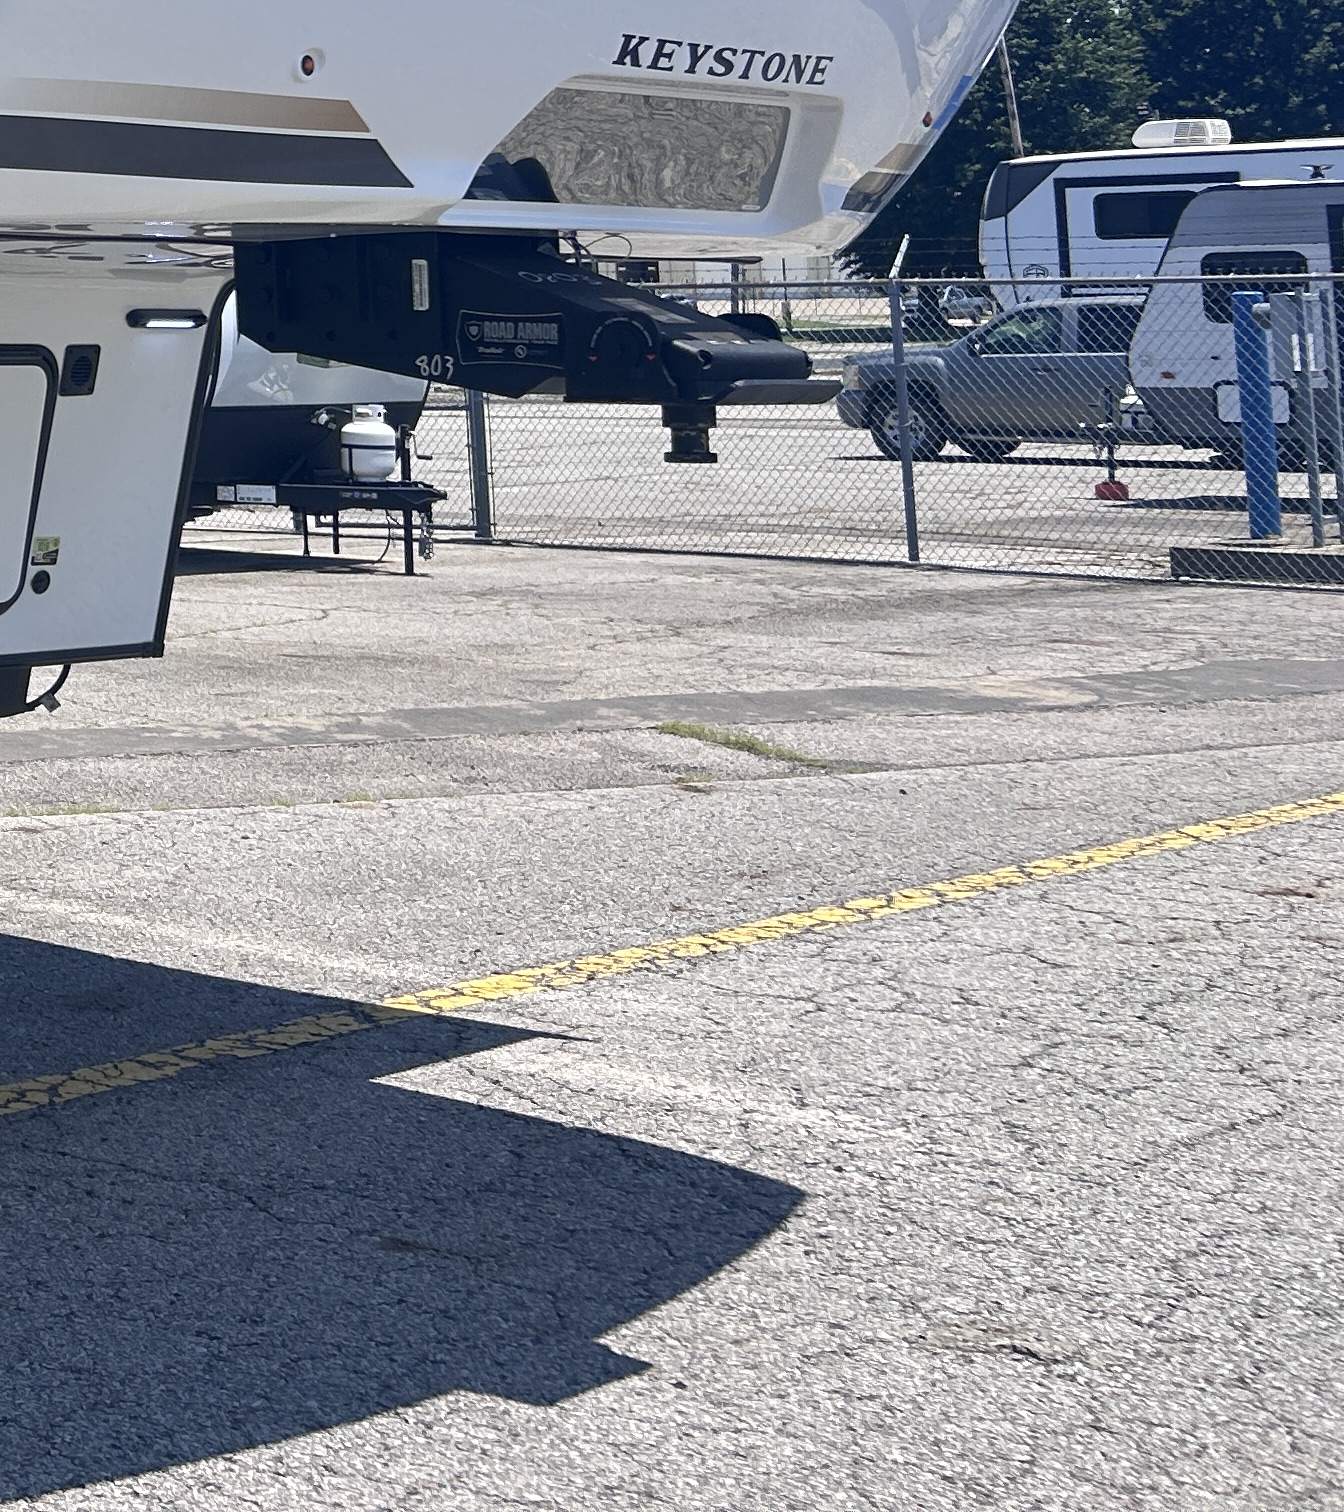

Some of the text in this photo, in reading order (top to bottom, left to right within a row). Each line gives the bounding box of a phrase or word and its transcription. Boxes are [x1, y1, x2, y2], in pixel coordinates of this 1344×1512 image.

[612, 33, 834, 85] KEYSTONE
[483, 320, 558, 340] ROAD ARMOR
[415, 354, 454, 380] 803
